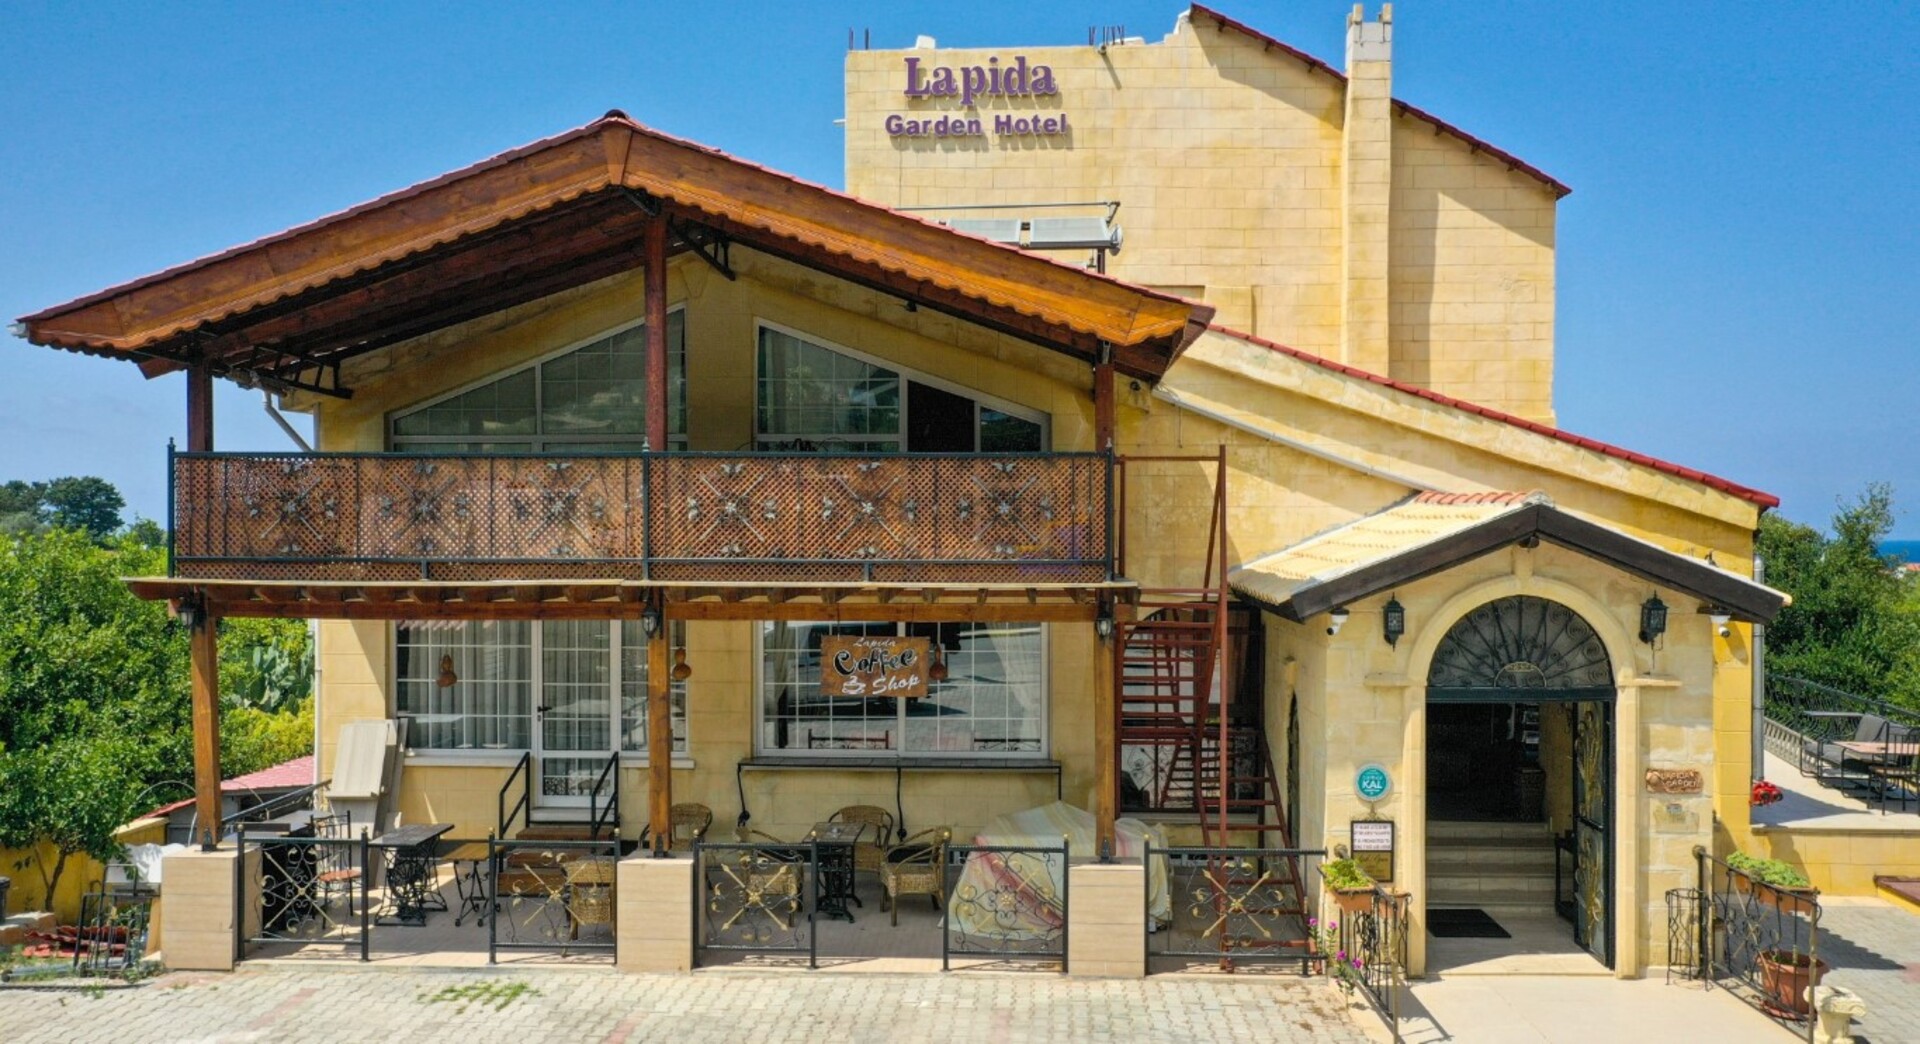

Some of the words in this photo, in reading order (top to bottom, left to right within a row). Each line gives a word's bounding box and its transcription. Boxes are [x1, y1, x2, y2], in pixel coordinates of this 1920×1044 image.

[904, 55, 1058, 105] Lapida
[885, 114, 982, 136] Garden
[994, 113, 1067, 135] Hotel
[853, 637, 896, 648] Lapida
[833, 648, 917, 677] Coffee
[872, 674, 920, 694] Shop
[1362, 779, 1383, 789] KAL
